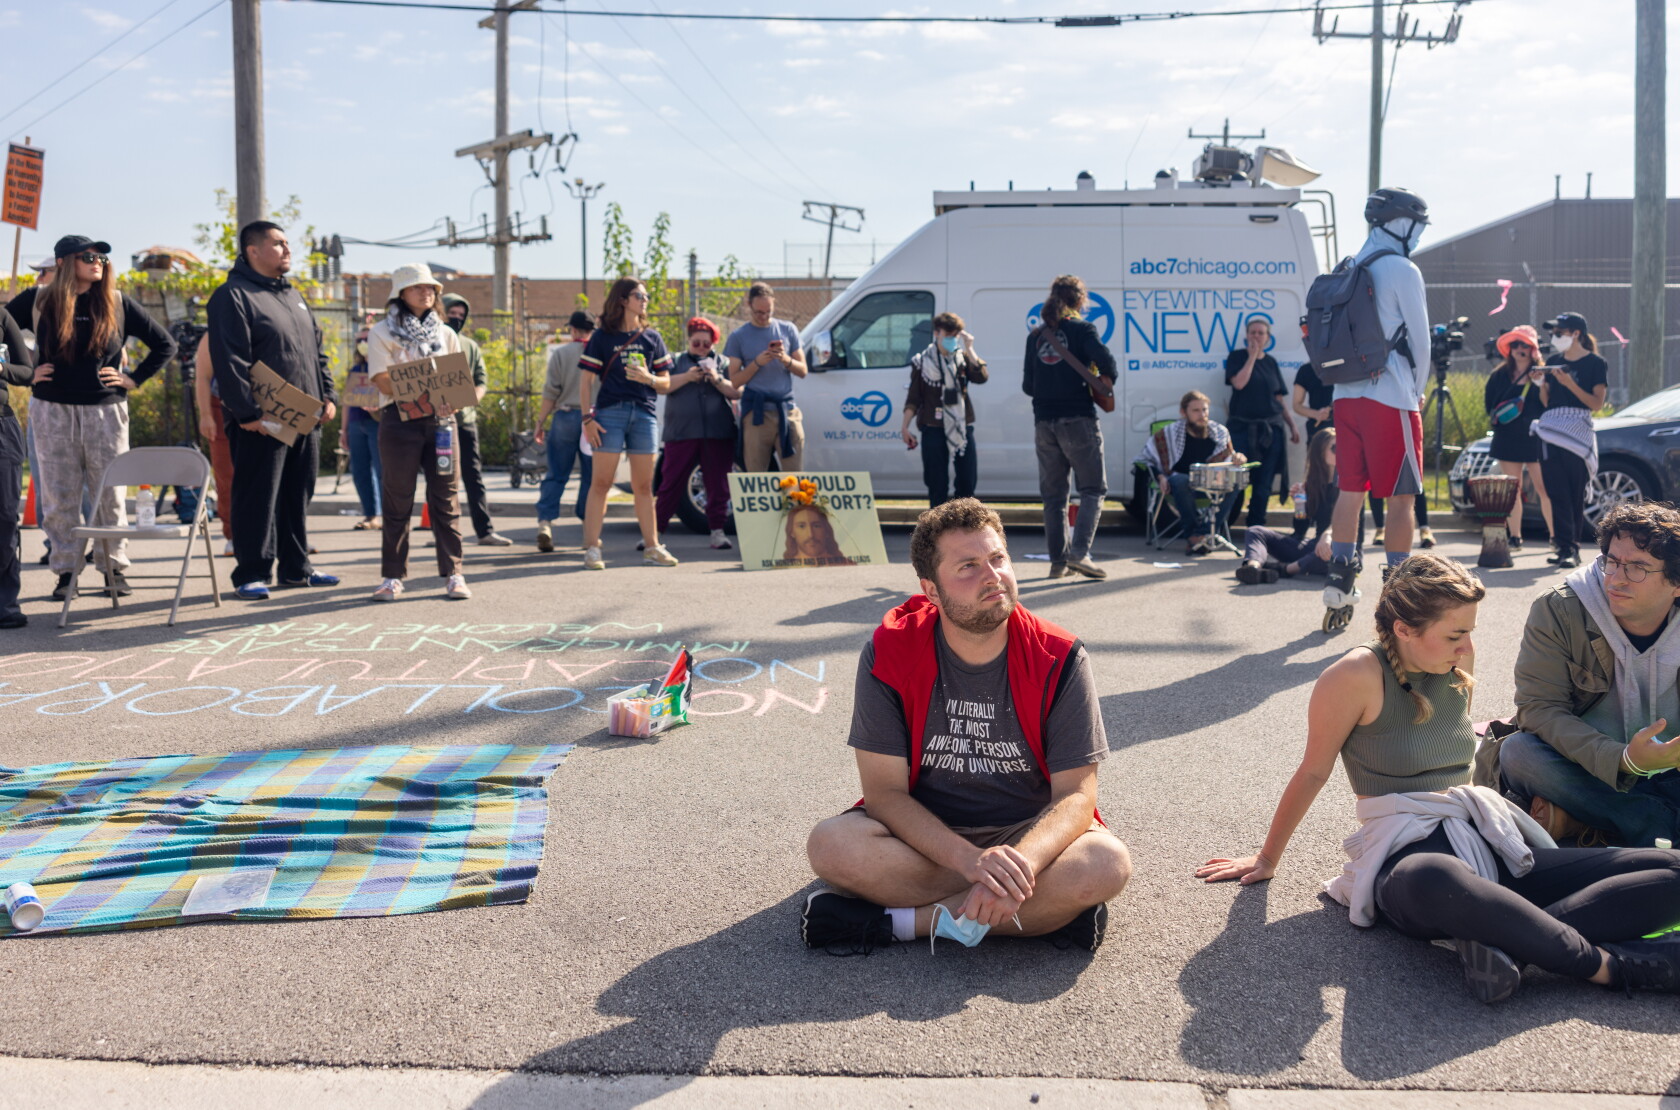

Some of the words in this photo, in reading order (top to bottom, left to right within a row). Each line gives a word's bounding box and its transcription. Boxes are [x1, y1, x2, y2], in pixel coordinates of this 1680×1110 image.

[1129, 258, 1296, 278] abc7chicago.com
[1123, 289, 1276, 310] EYEWITNESS
[390, 362, 436, 382] CHINGA
[250, 376, 277, 401] UCK
[397, 383, 416, 396] LA
[418, 369, 472, 393] MIGRA
[266, 401, 306, 428] ICE
[841, 402, 864, 412] abc
[823, 430, 864, 440] WLS-TV
[866, 430, 903, 440] CHICAG
[230, 622, 373, 637] HERE
[379, 622, 663, 636] WELCOME
[151, 636, 302, 655] ARE
[303, 636, 750, 654] IMMIGRANTS
[0, 652, 678, 682] CAPITULATIO
[692, 657, 825, 684] NO
[688, 687, 829, 717] NO
[958, 700, 995, 719] LITERALLY
[949, 718, 963, 734] THE
[965, 718, 990, 738] MOST
[926, 734, 973, 754] AWEOME
[974, 740, 1022, 758] PERSON
[921, 753, 937, 767] IN
